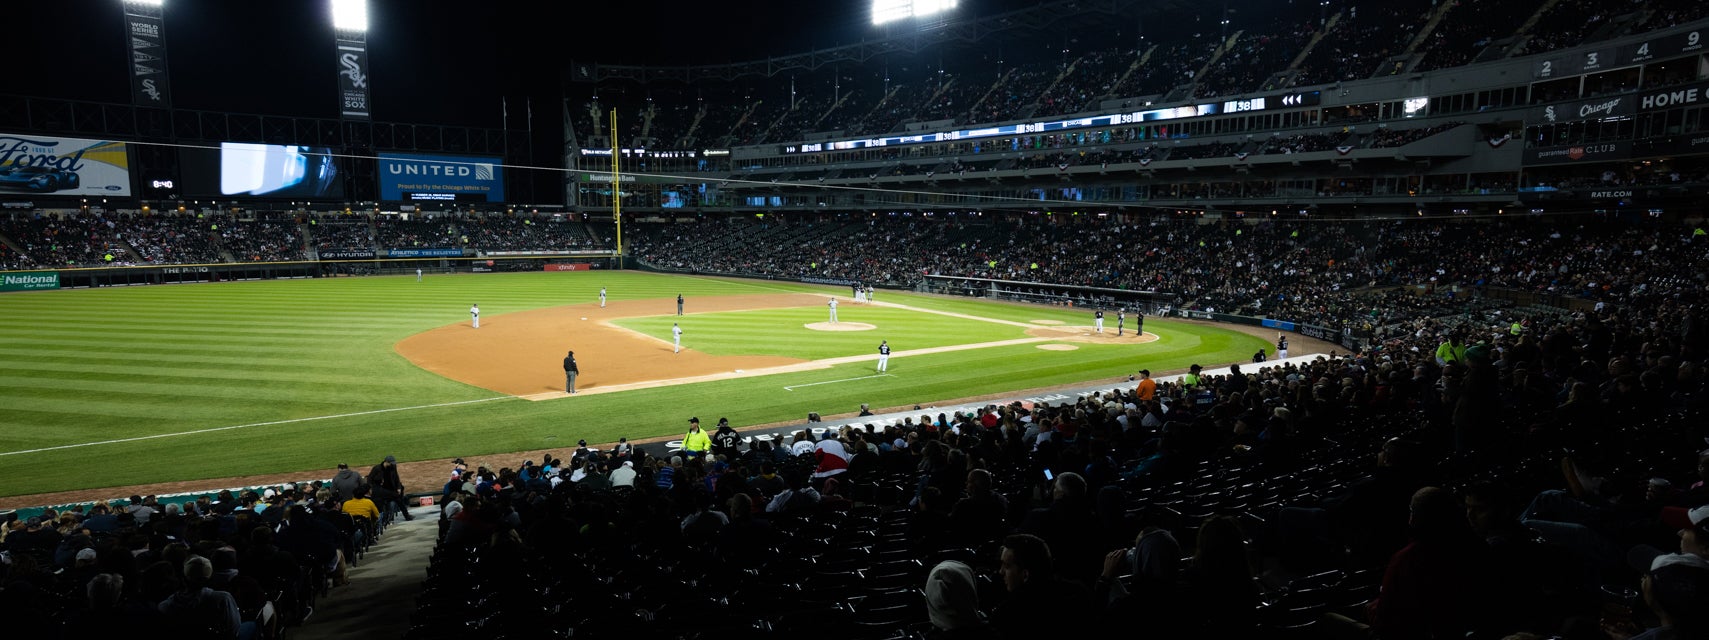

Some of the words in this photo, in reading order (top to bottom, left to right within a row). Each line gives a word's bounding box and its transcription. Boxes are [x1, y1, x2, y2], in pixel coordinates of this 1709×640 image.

[131, 22, 158, 30] WORLD
[1688, 31, 1700, 46] 9
[1637, 42, 1649, 55] 4
[1587, 52, 1598, 65] 3
[1541, 61, 1551, 73] 2
[1642, 88, 1698, 109] HOME
[345, 101, 365, 109] SOX
[1237, 102, 1251, 111] 38
[1580, 98, 1621, 117] Chicago
[1121, 114, 1132, 123] 38
[1025, 124, 1035, 133] 38
[943, 132, 953, 141] 38
[0, 136, 84, 172] Ford
[1538, 149, 1570, 158] guaranteed
[1570, 147, 1583, 155] Rate
[1586, 144, 1616, 154] CLUB
[389, 163, 470, 176] UNITED
[153, 180, 173, 188] 8:40
[590, 174, 621, 183] Huntingn
[1591, 190, 1632, 198] RATE.COM
[5, 274, 57, 284] National
[1301, 326, 1324, 339] StubHub
[723, 437, 734, 448] 12
